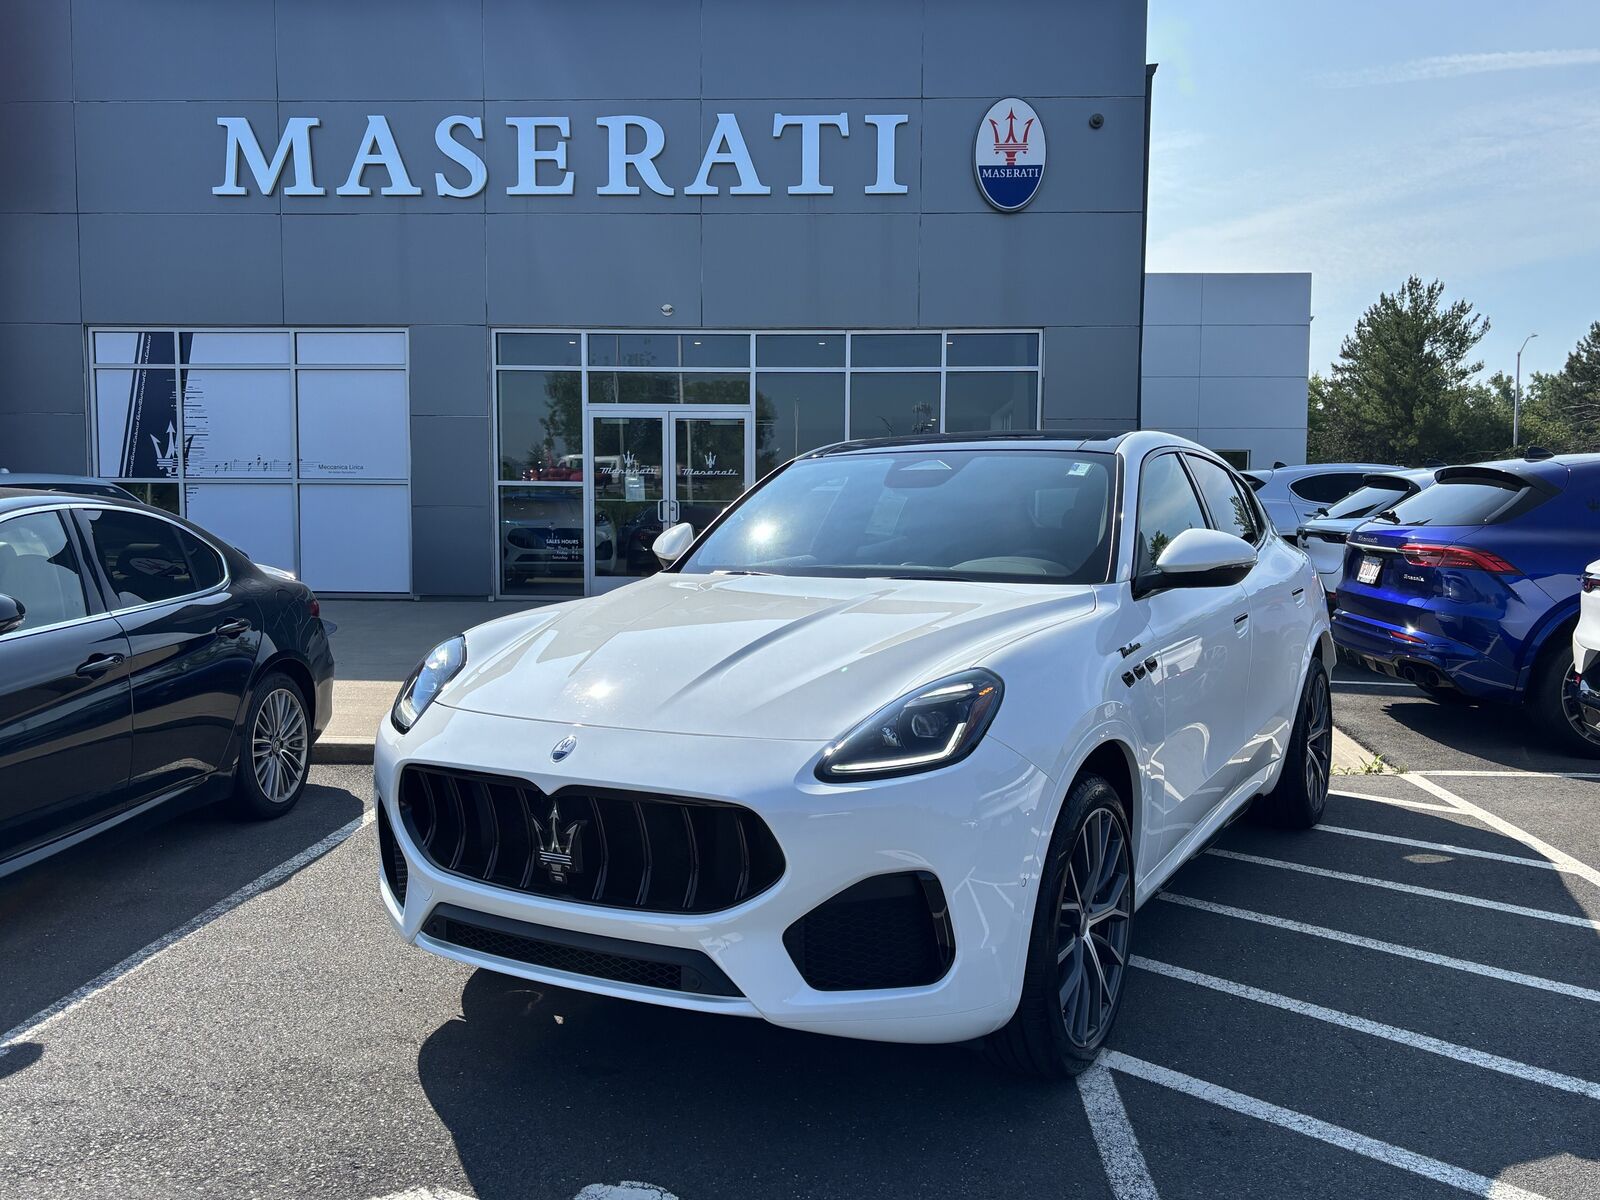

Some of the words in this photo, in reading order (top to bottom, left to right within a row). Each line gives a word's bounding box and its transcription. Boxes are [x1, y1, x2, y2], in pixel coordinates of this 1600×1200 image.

[212, 112, 909, 198] MASERATI
[982, 168, 1039, 178] MASERATI
[600, 467, 657, 475] Maserati
[681, 468, 739, 476] Maserati
